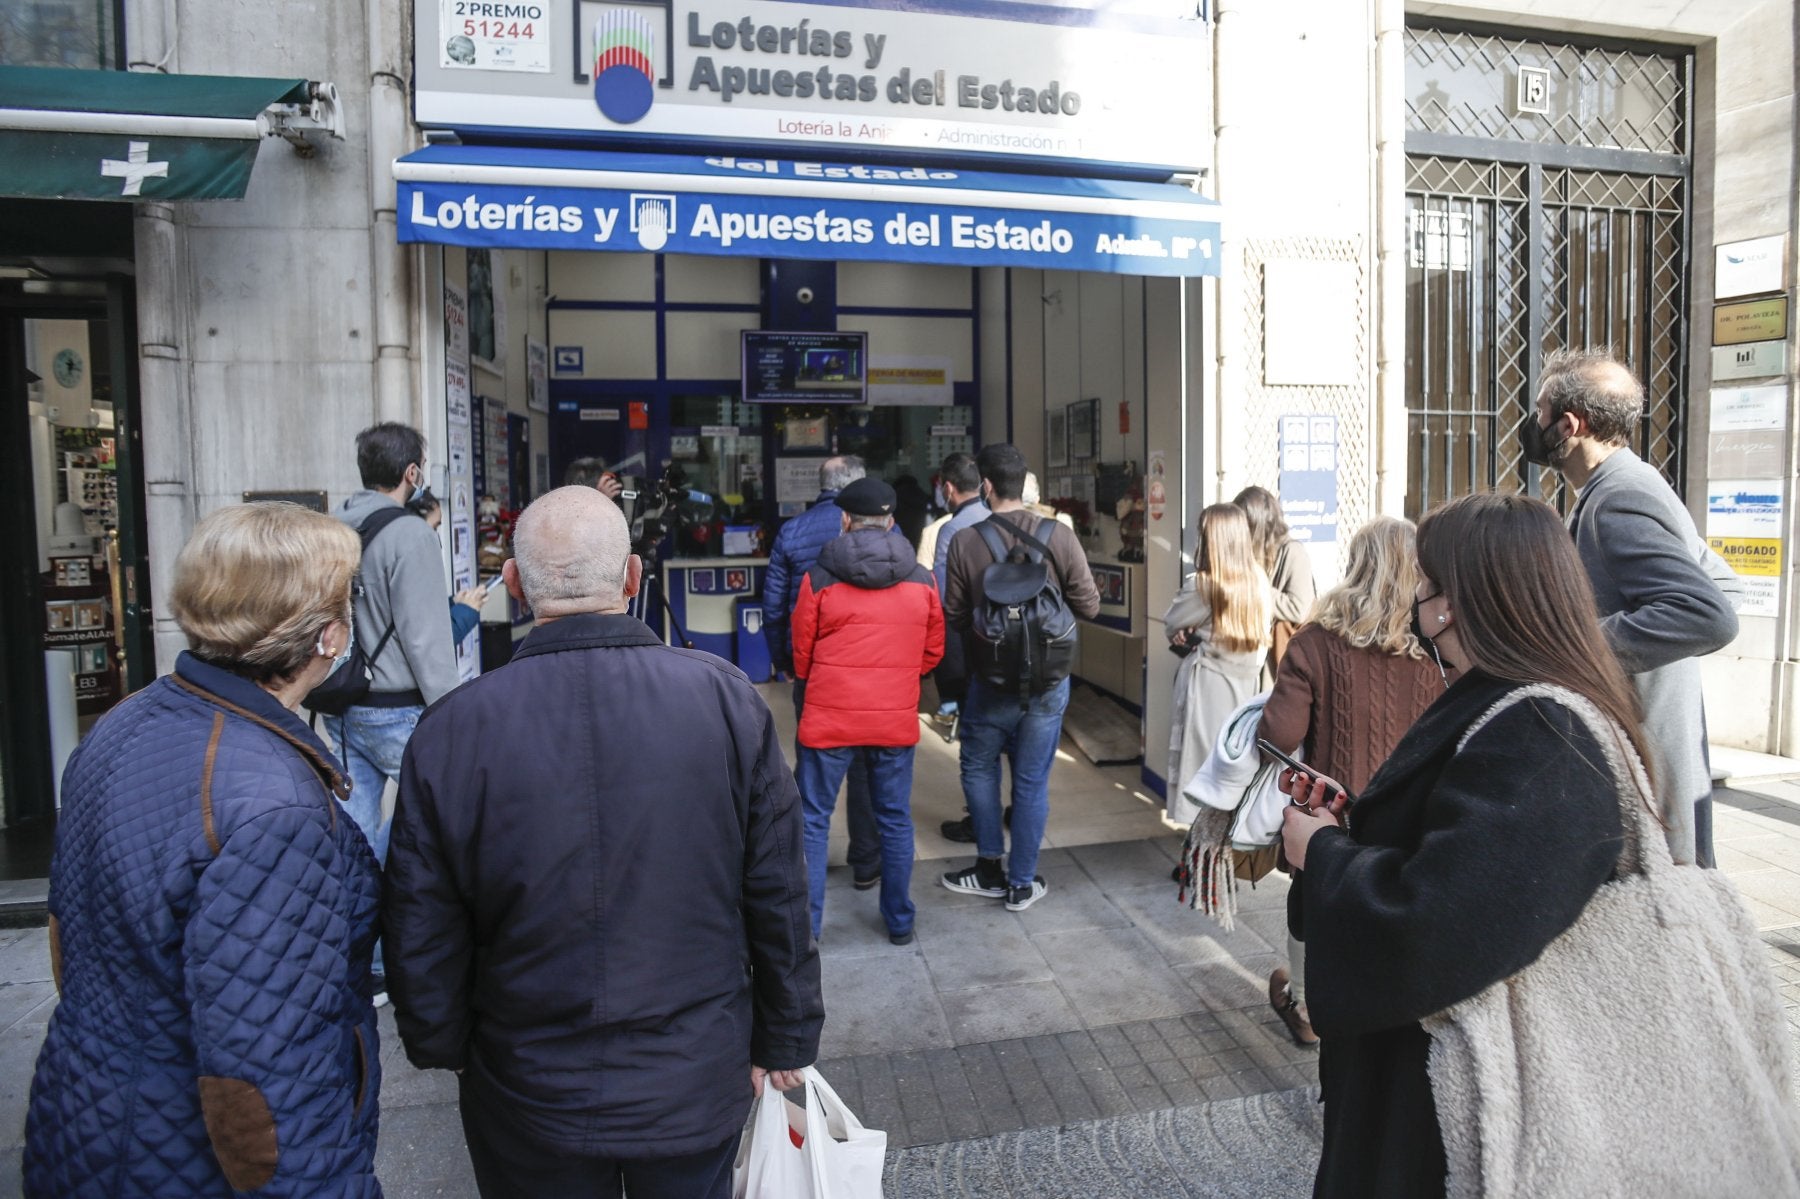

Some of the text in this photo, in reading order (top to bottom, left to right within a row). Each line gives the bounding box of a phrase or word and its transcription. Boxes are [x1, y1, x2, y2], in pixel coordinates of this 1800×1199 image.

[470, 2, 542, 19] PREMIO
[464, 19, 534, 39] 51244
[688, 11, 887, 69] Loterías y
[689, 56, 1081, 116] Apuestas del Estado
[1526, 73, 1544, 102] 15
[778, 118, 833, 136] Lotería
[838, 121, 853, 137] la
[937, 128, 1052, 150] Administración
[794, 162, 958, 180] Estado
[411, 191, 583, 232] Loterías
[594, 208, 619, 242] y
[690, 204, 874, 247] Apuestas
[884, 213, 940, 246] del
[951, 215, 1073, 253] Estado
[1723, 545, 1777, 556] ABOGADO
